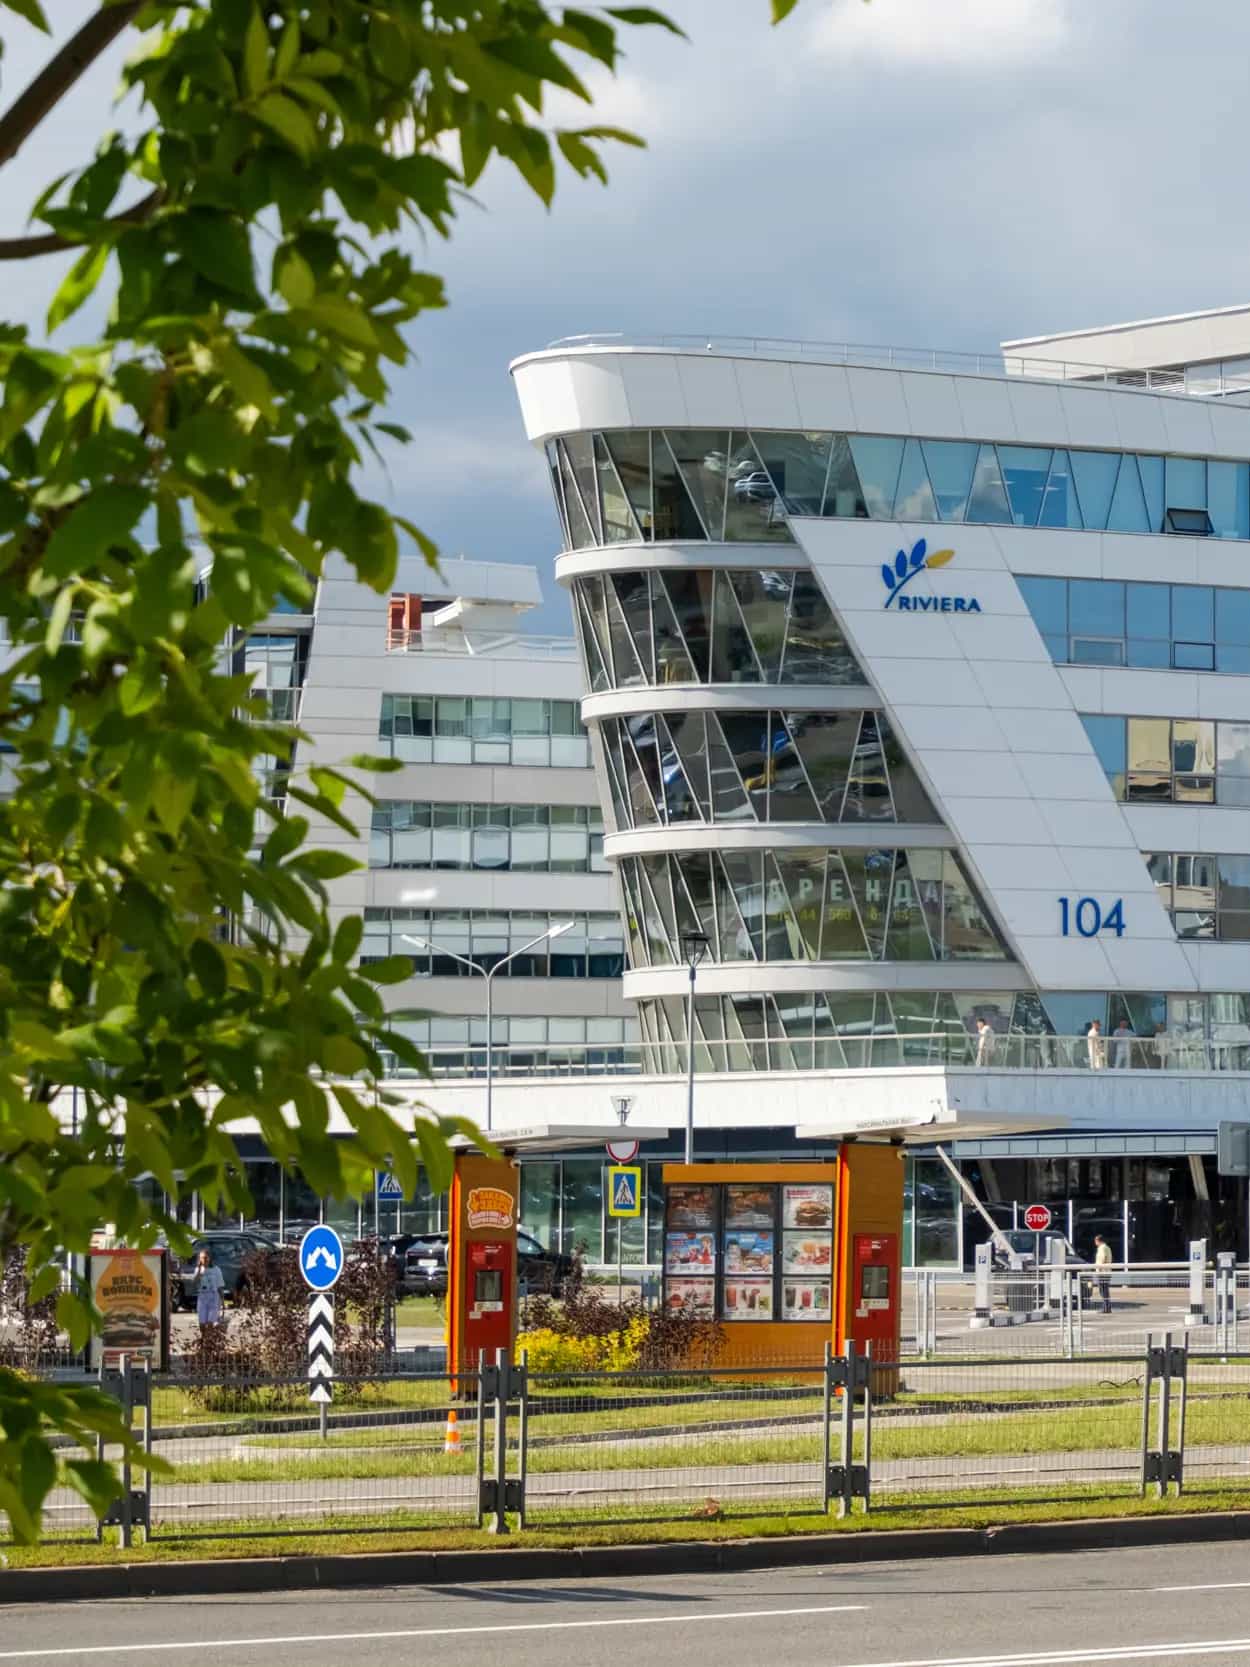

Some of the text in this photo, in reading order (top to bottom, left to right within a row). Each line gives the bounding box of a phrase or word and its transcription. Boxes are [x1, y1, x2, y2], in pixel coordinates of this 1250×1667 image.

[898, 596, 982, 612] RIVIERA
[767, 879, 940, 907] АРЕНДА
[1058, 897, 1126, 938] 104
[1027, 1213, 1049, 1223] STOP
